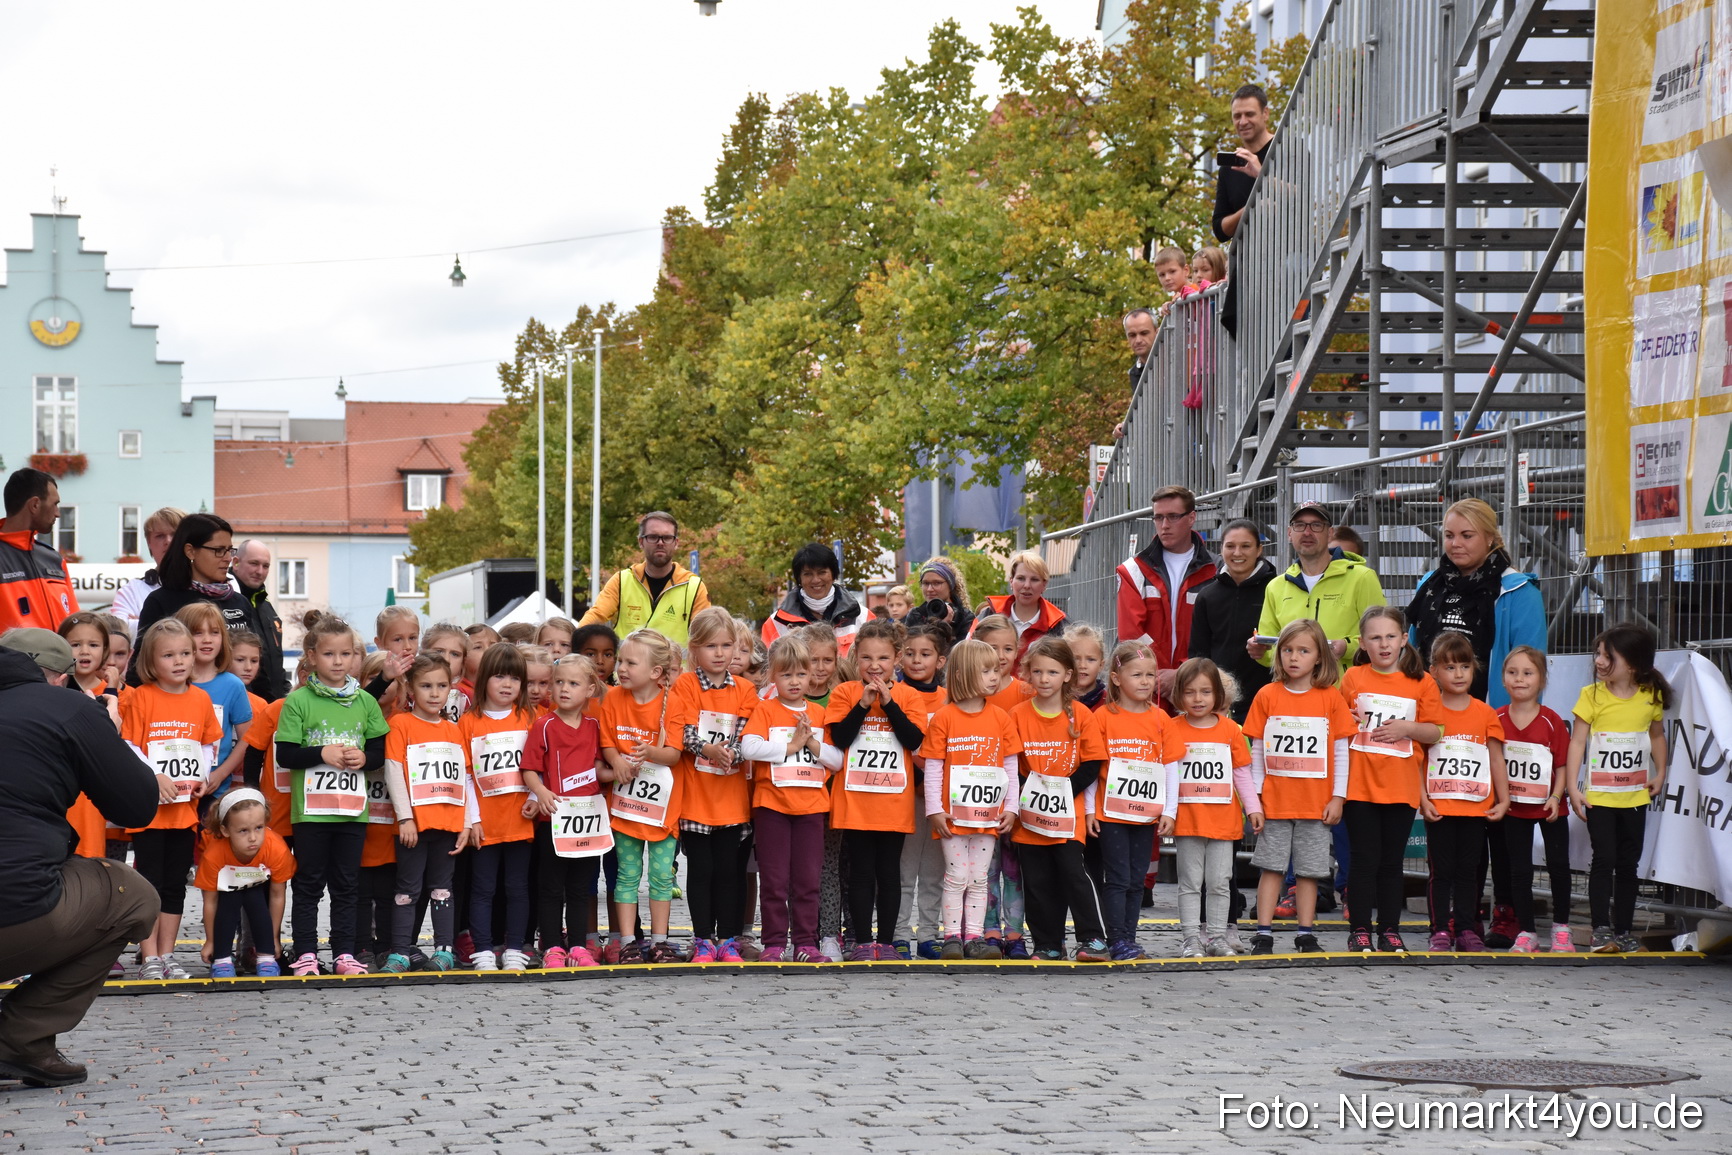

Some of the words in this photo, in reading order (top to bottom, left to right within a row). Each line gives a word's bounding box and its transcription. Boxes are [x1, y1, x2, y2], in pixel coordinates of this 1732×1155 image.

[1641, 330, 1698, 361] PFLEIDERER
[1099, 448, 1112, 459] Bru
[71, 573, 129, 590] aufsp
[149, 720, 189, 728] umarkter
[616, 725, 650, 737] eumarkter
[148, 729, 179, 738] adtlauf
[1440, 733, 1473, 741] markter
[1108, 738, 1149, 746] Neumarkter
[1273, 735, 1318, 754] 7212
[479, 749, 523, 773] 7220
[783, 746, 818, 765] 15
[857, 749, 898, 769] 7272
[1598, 750, 1643, 769] 7054
[156, 758, 200, 778] 7032
[418, 761, 459, 780] 7105
[796, 769, 811, 777] Lena
[1182, 761, 1224, 780] 7003
[1437, 758, 1482, 778] 7357
[314, 771, 358, 791] 7260
[572, 774, 590, 785] DEHN
[864, 772, 892, 787] LEA
[1614, 775, 1630, 783] Nora
[960, 785, 1002, 804] 7050
[1117, 777, 1158, 800] 7040
[1433, 781, 1481, 795] MELISSA
[1508, 784, 1527, 793] Emma
[618, 799, 649, 813] Franziska
[1029, 790, 1067, 814] 7034
[1128, 803, 1145, 812] Frida
[974, 810, 990, 818] Frida
[561, 814, 601, 834] 7077
[1035, 816, 1060, 828] Patricia
[576, 840, 590, 848] Leni
